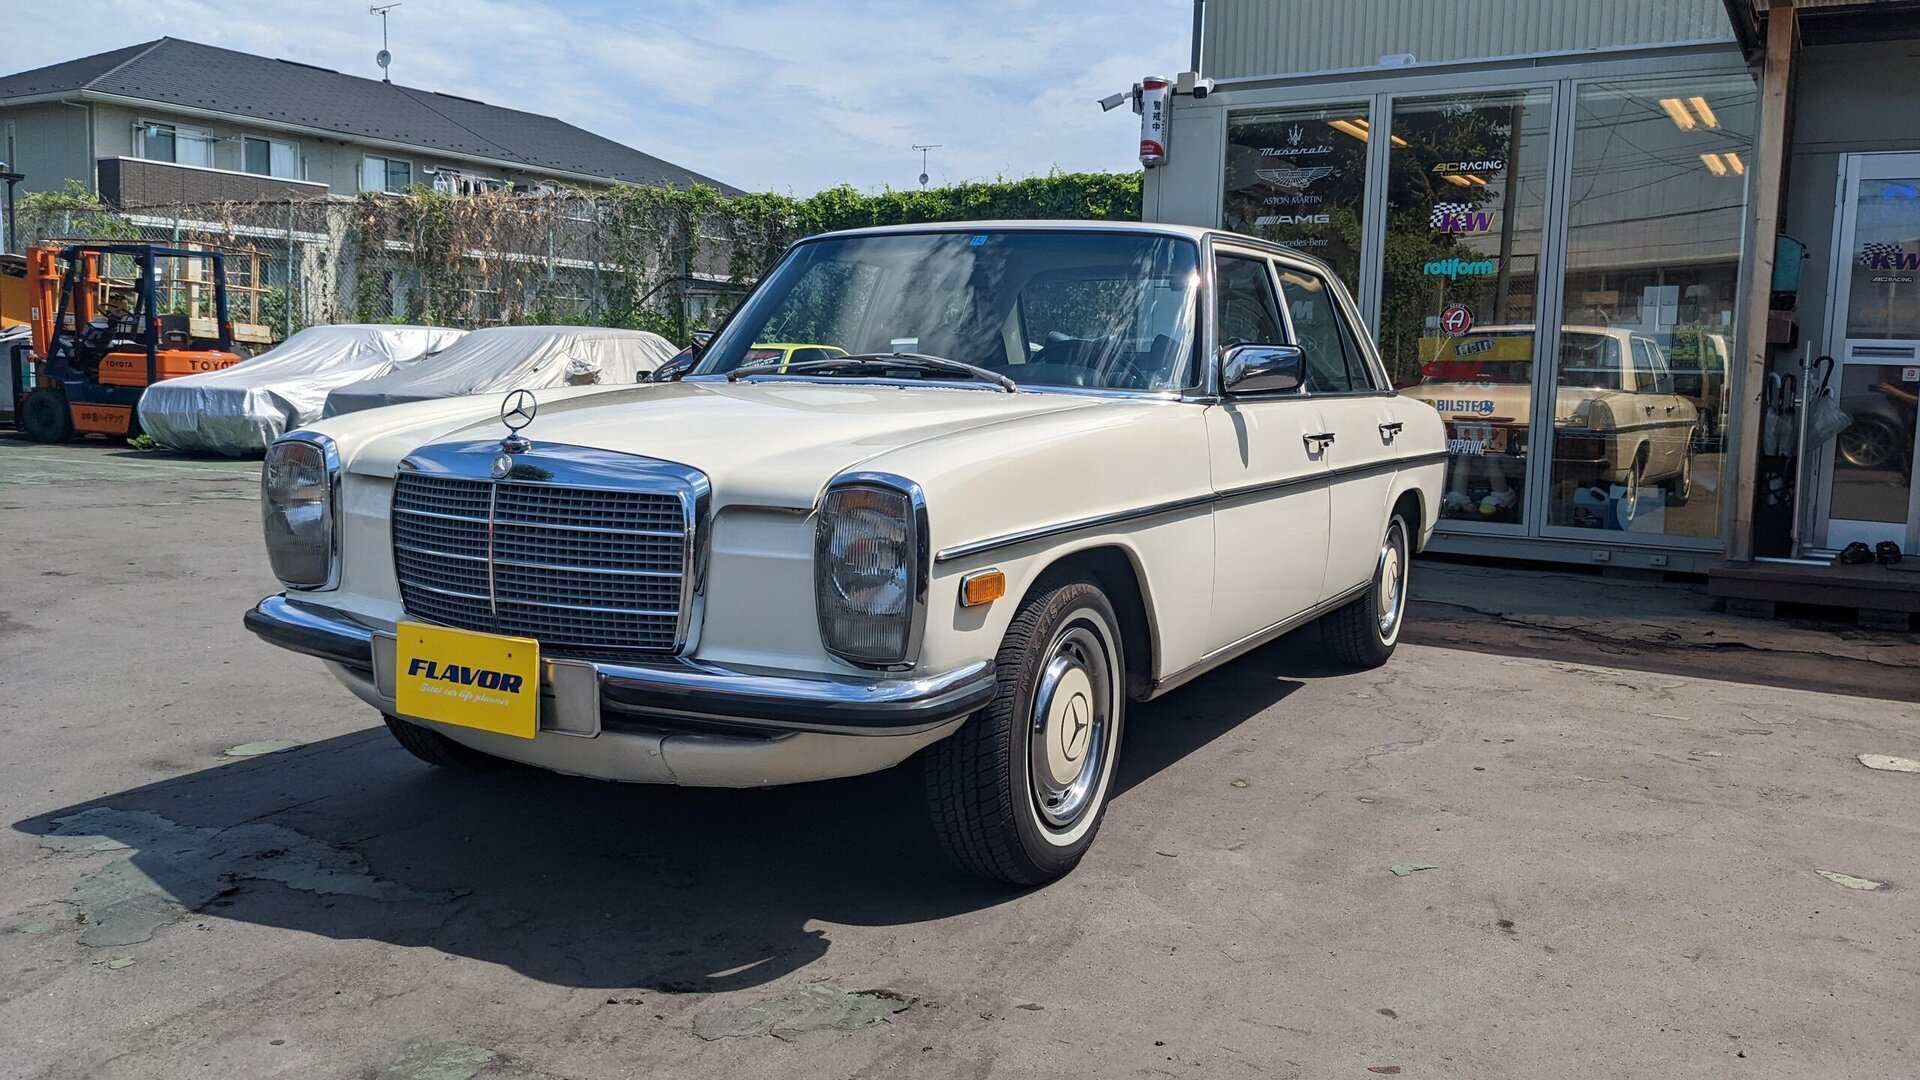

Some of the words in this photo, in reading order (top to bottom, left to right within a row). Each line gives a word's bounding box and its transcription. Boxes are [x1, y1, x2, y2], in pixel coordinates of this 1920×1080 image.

[1152, 100, 1161, 131] 警戒中
[1259, 144, 1332, 157] Maserati
[1263, 196, 1290, 205] ASTON
[1291, 195, 1323, 204] MARTIN
[1276, 214, 1330, 225] AMG
[1440, 211, 1496, 233] KW
[1423, 258, 1494, 280] rotiform
[1869, 252, 1920, 270] KW
[105, 360, 133, 369] TOYOTA
[188, 359, 239, 371] TOYOT
[408, 658, 523, 694] FLAVOR
[420, 682, 442, 694] Total
[442, 688, 457, 697] car
[458, 689, 474, 703] life
